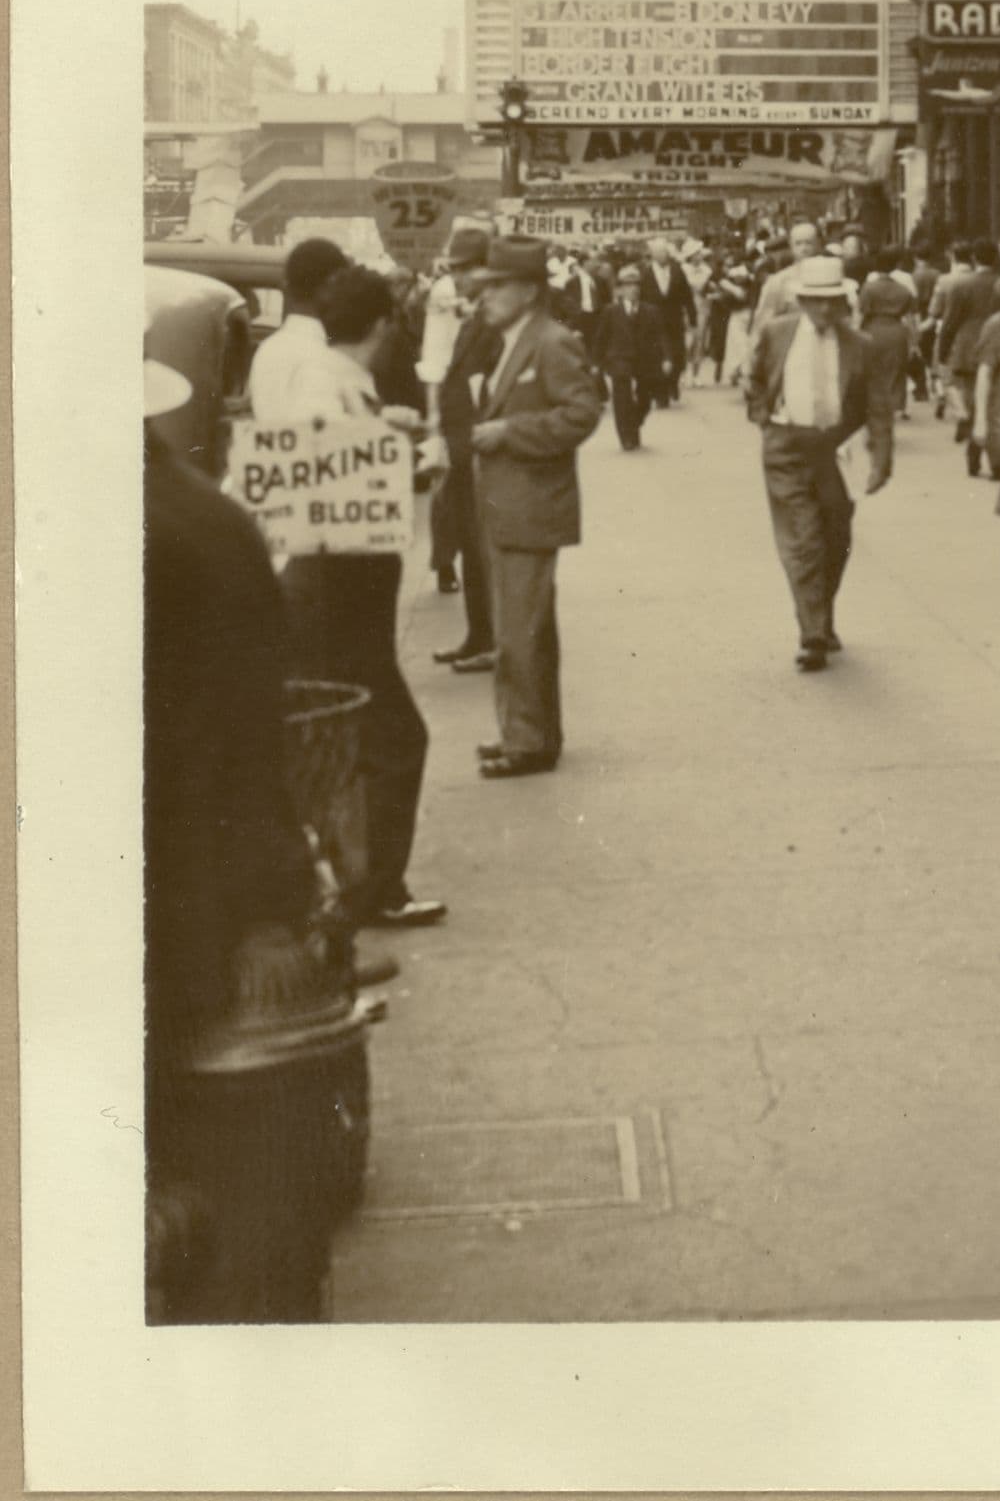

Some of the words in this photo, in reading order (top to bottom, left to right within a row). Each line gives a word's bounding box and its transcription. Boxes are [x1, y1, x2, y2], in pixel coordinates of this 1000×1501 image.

[698, 1, 813, 23] DONLEVY
[547, 27, 606, 48] HIGH
[612, 27, 717, 48] TENSION
[524, 54, 629, 75] BORDER
[634, 54, 719, 75] FLIGHT
[565, 80, 650, 102] GRANT
[656, 80, 764, 102] WITHERS
[618, 106, 673, 120] EVERY
[682, 106, 760, 120] MORNING
[809, 106, 873, 120] SUNDAY
[582, 129, 826, 165] AMATEUR
[654, 151, 748, 169] NIGHT
[590, 205, 652, 219] CHINA
[581, 220, 659, 234] CLIPPER
[254, 429, 298, 452] NO
[244, 435, 399, 504] PARKING
[308, 499, 402, 525] BLOCK
